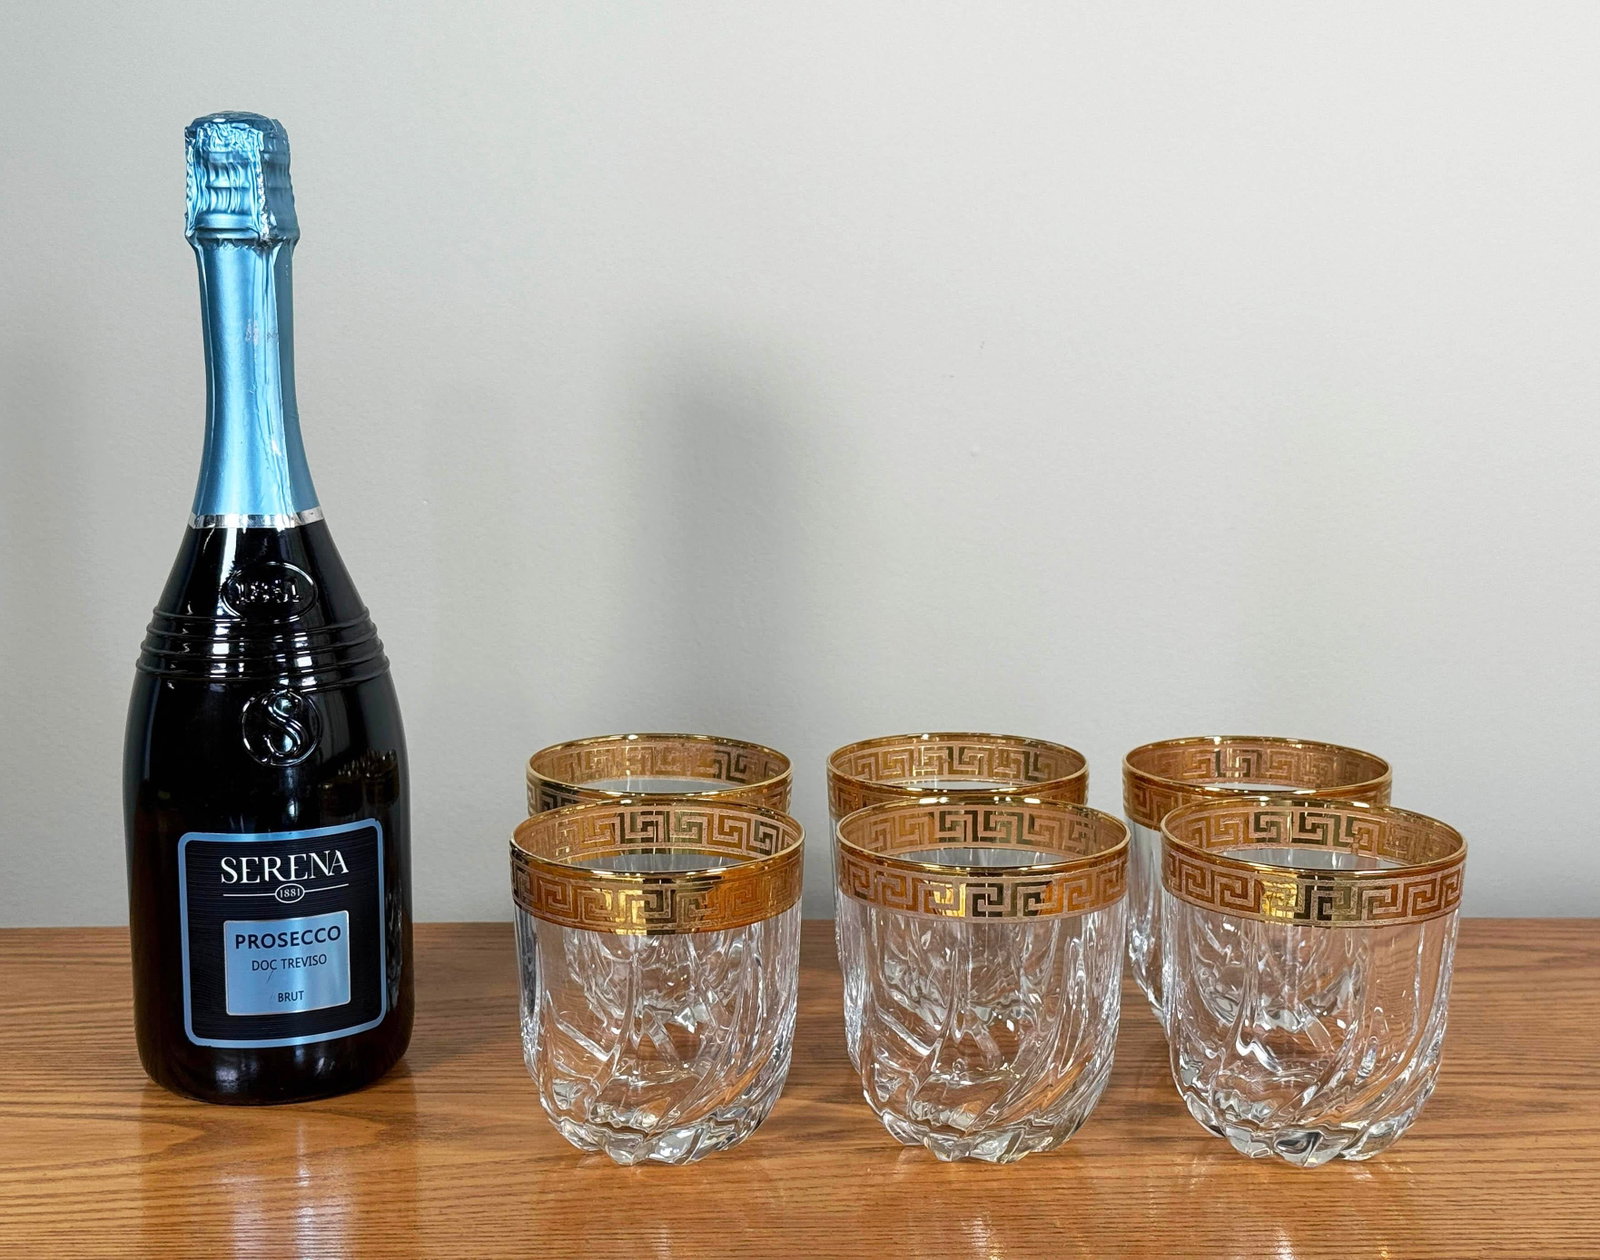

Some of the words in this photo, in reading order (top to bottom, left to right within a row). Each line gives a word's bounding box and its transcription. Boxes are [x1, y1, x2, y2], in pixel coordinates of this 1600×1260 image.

[220, 849, 349, 884] SERENA
[279, 887, 301, 899] 1881
[235, 925, 341, 949] PROSECCO
[251, 959, 278, 971] DOC
[281, 953, 327, 969] TREVISO
[277, 990, 305, 1003] BRUT
